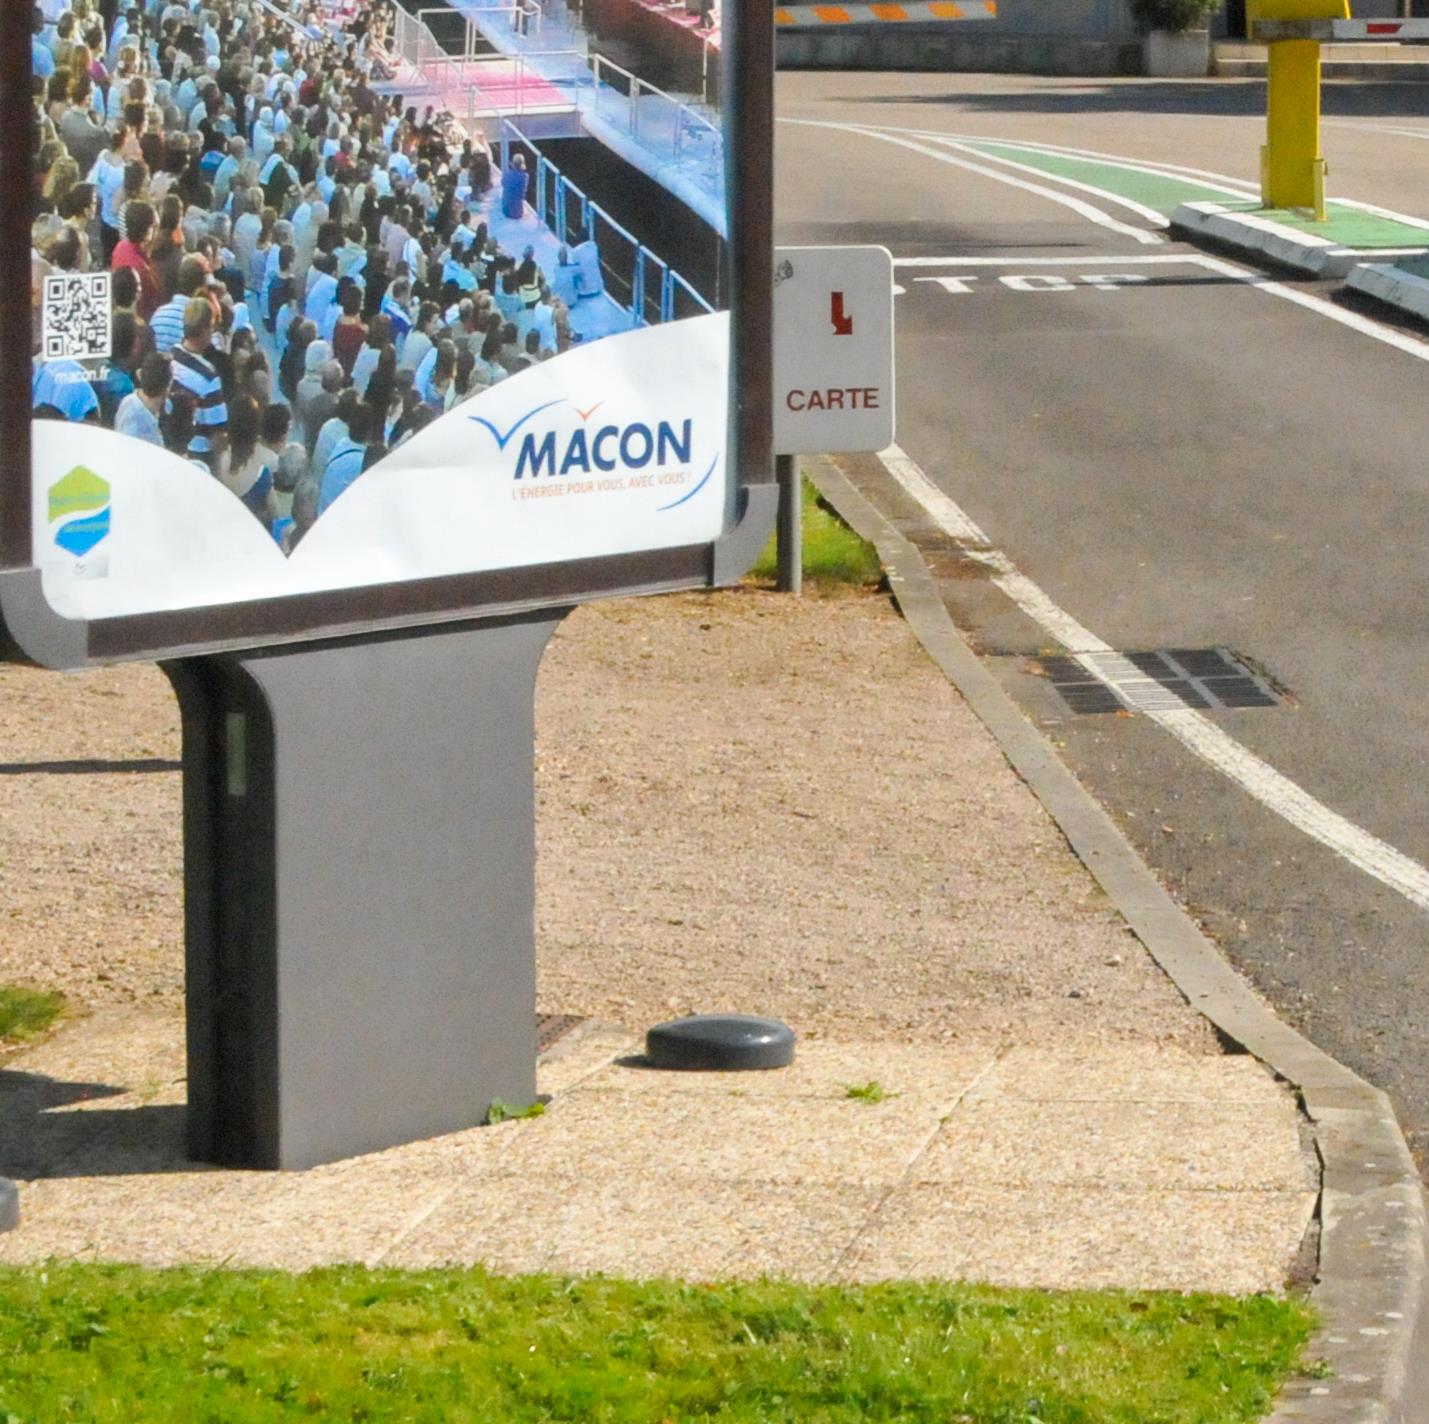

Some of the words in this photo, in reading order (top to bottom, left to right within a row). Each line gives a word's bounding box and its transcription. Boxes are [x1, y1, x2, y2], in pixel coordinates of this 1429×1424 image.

[786, 387, 880, 412] CARTE
[513, 418, 693, 480] MACON
[567, 479, 594, 494] POUR
[628, 474, 654, 488] AVEC
